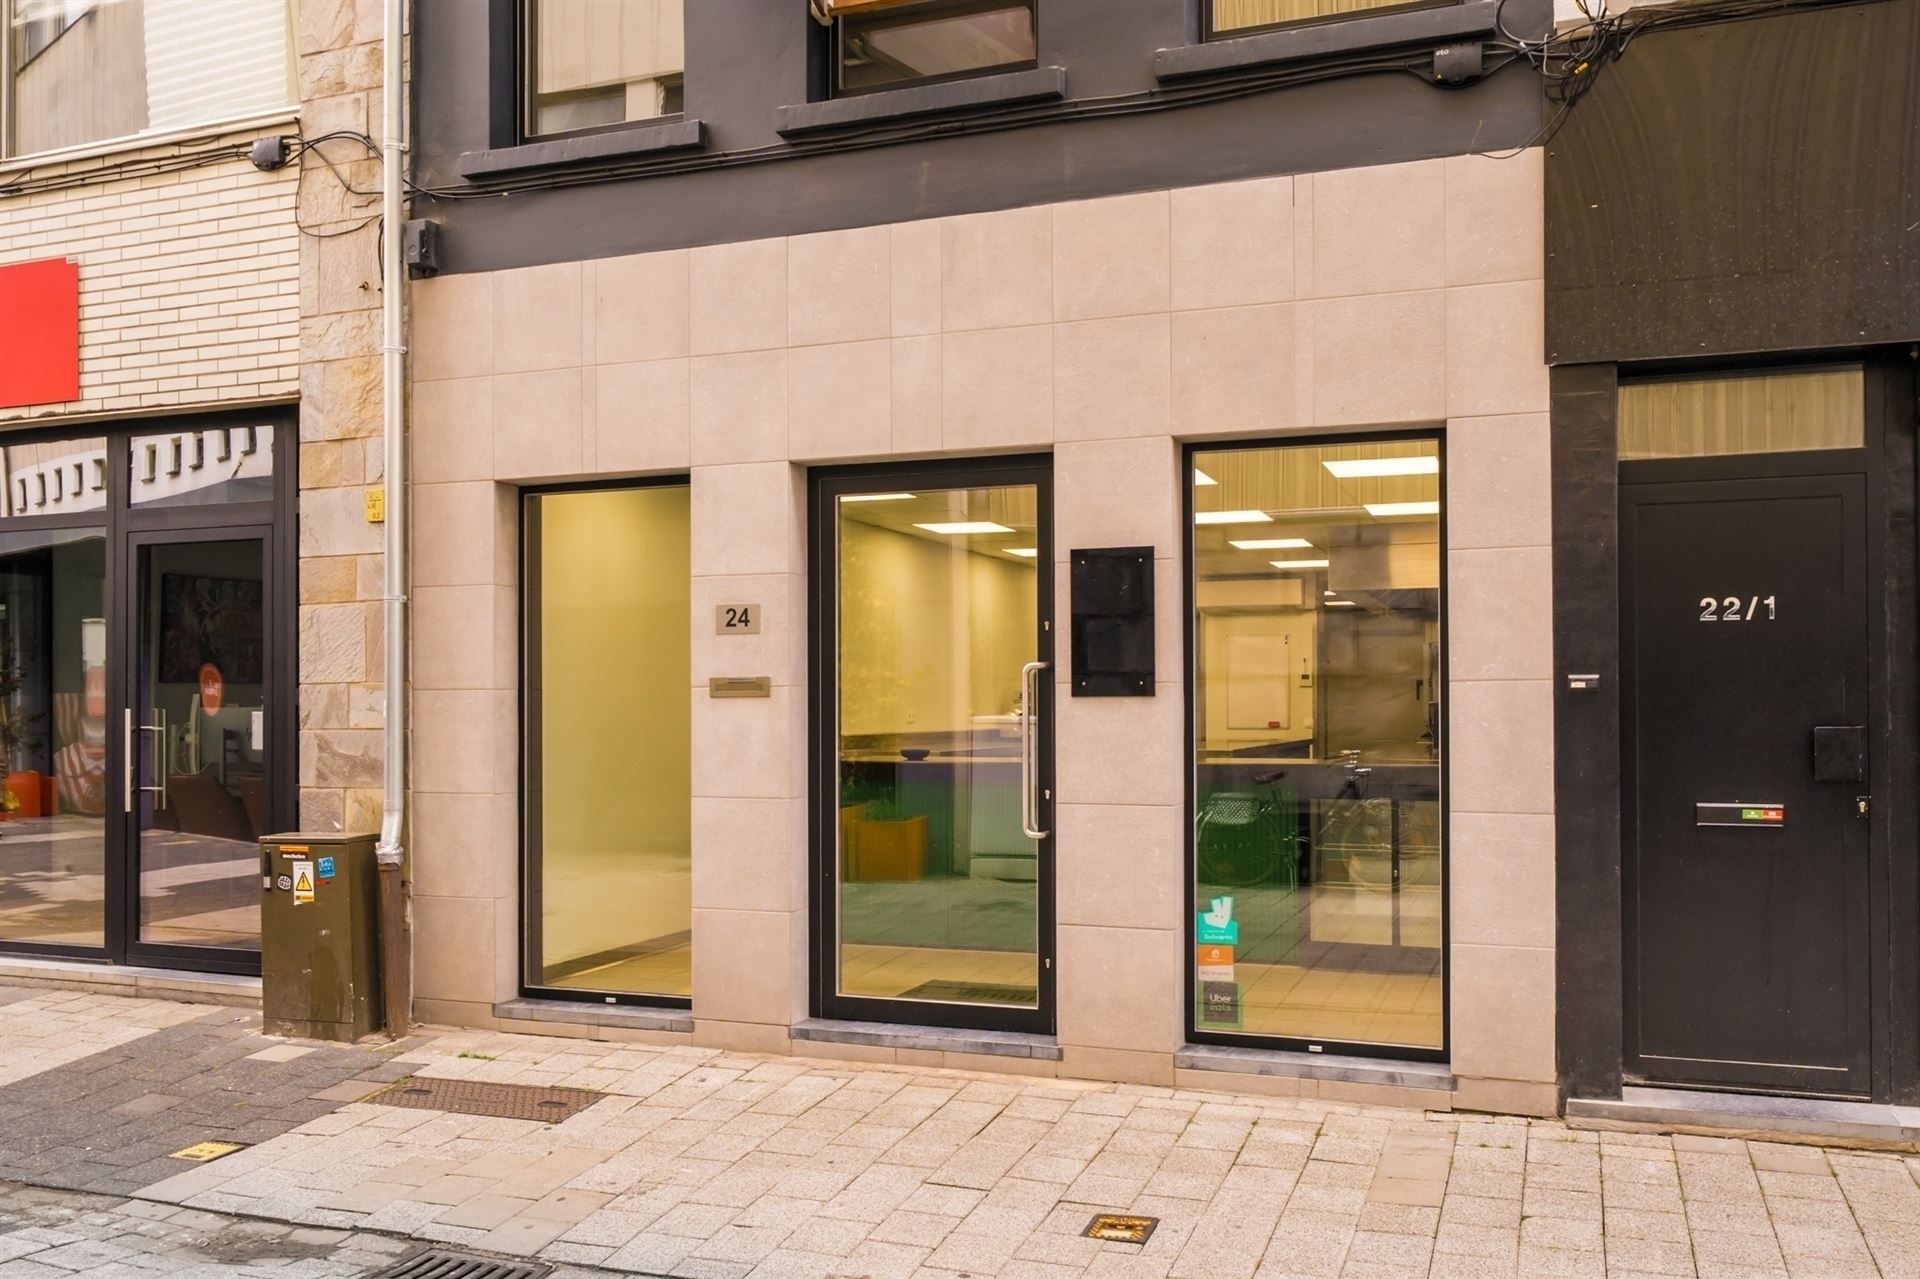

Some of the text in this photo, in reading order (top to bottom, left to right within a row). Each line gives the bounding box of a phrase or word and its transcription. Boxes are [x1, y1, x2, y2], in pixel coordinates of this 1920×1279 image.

[725, 607, 751, 627] 24
[1699, 595, 1775, 621] 22/1
[1209, 993, 1231, 1004] Uber
